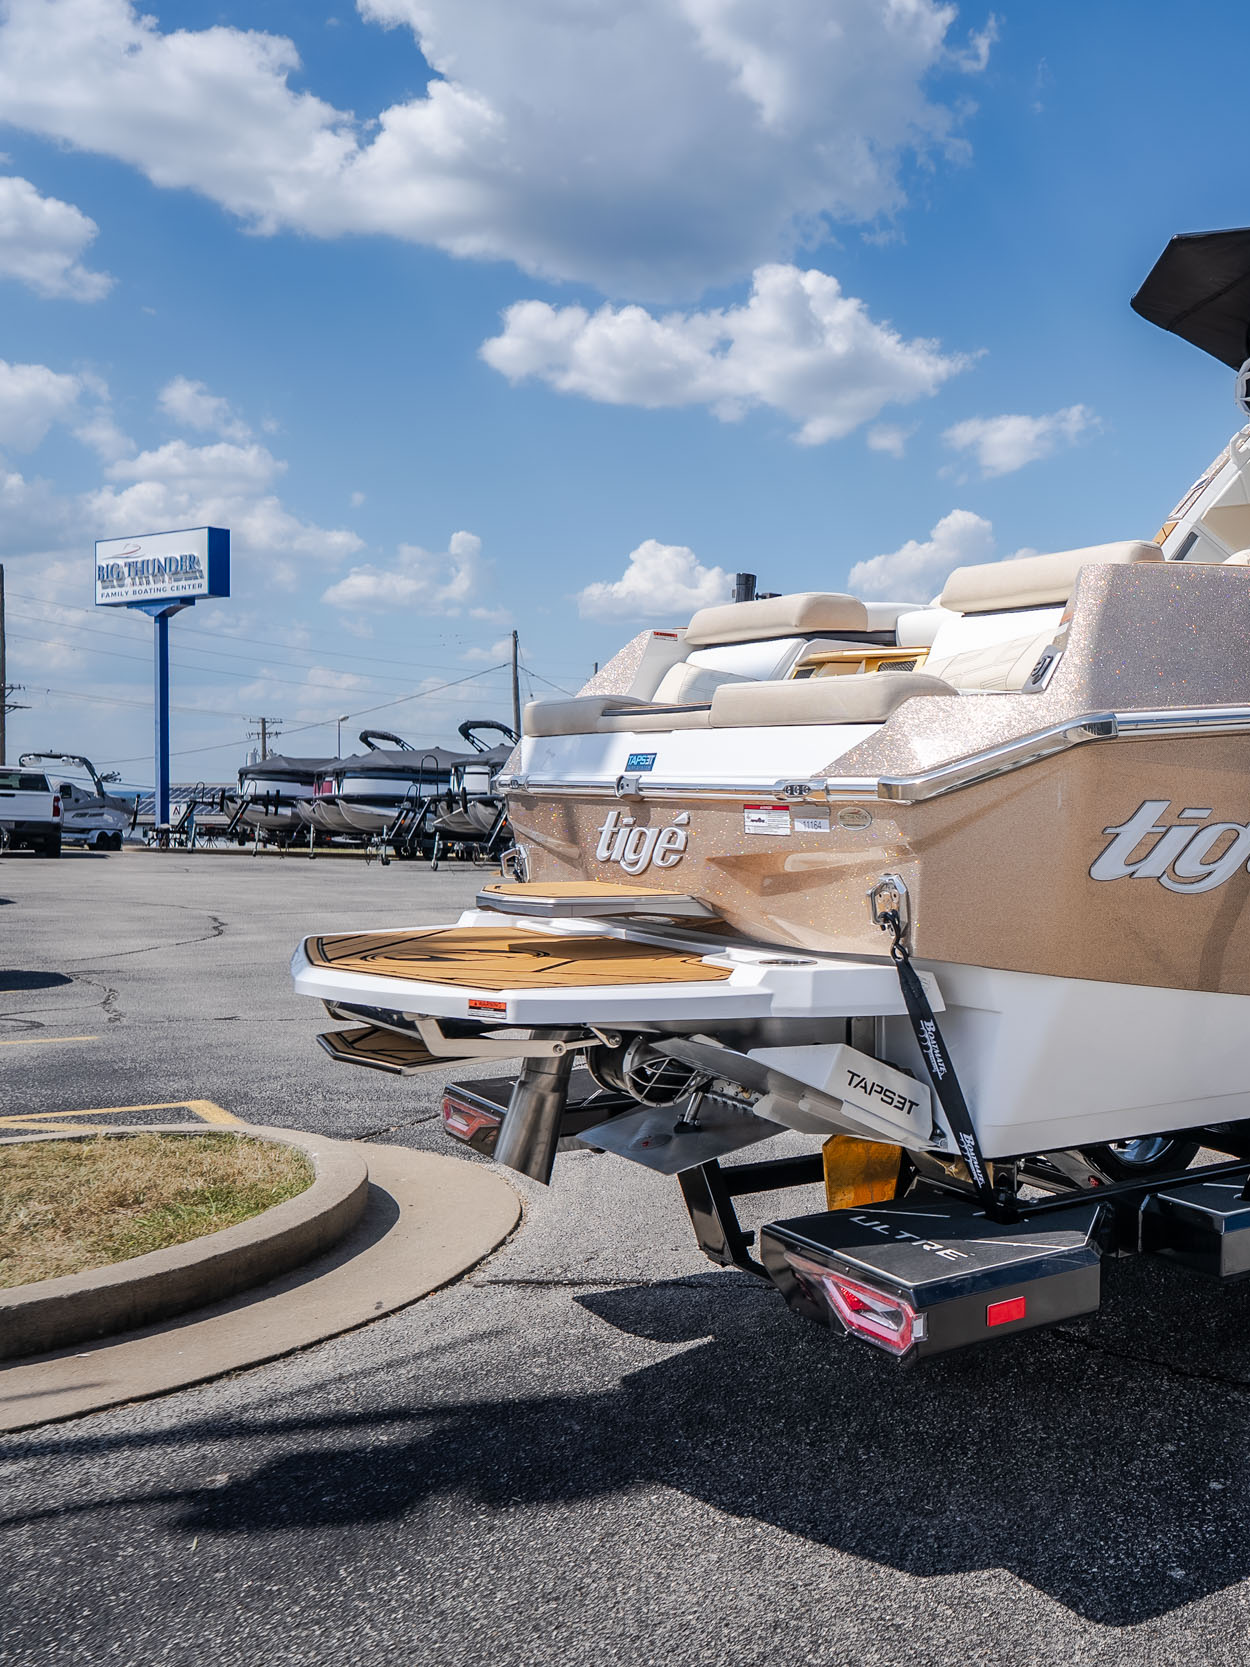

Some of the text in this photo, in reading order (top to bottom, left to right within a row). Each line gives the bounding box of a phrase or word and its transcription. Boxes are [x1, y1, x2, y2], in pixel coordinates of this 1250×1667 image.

[97, 554, 198, 581] BIG THUNDER
[101, 582, 203, 599] FAMILY BOATING CENTER
[596, 811, 691, 876] tigé
